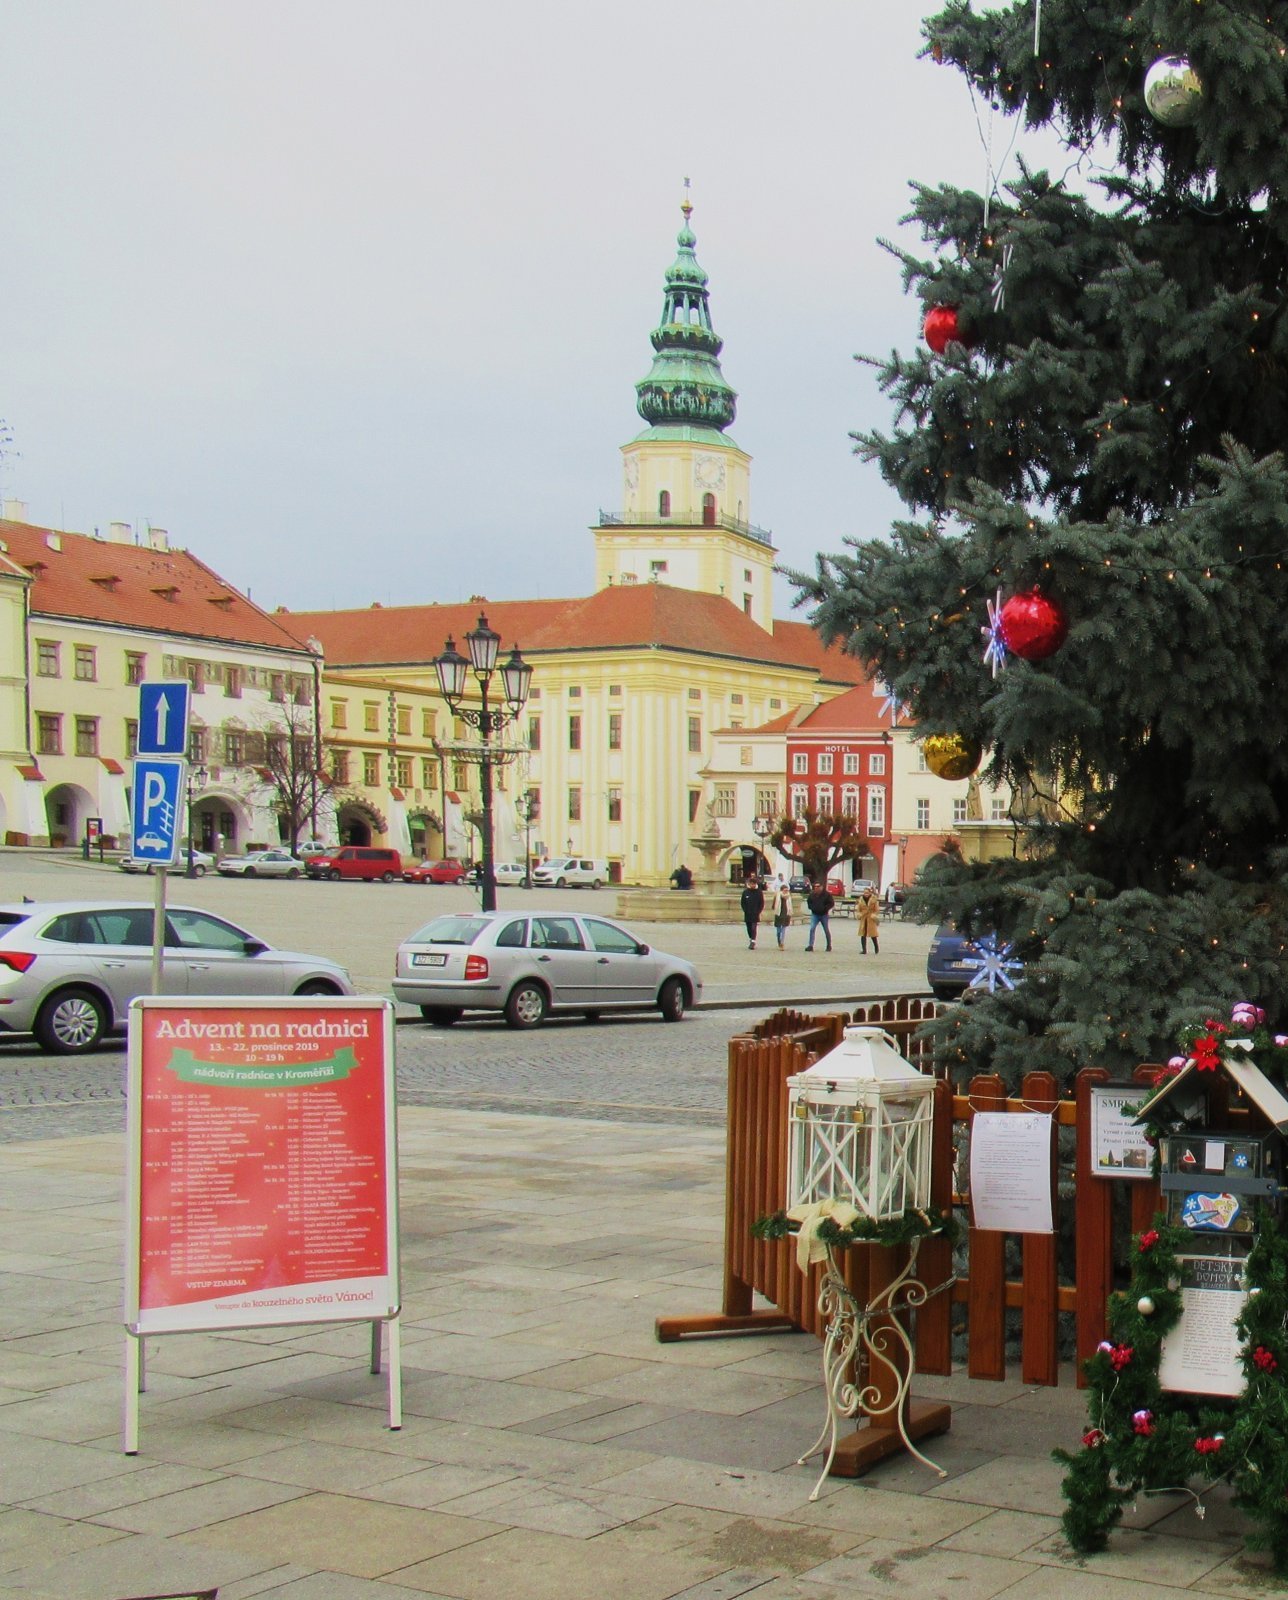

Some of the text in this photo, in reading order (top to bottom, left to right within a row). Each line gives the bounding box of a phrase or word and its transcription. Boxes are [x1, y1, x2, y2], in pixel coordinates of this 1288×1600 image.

[825, 745, 851, 753] HOTEL
[143, 772, 166, 825] P
[156, 1019, 369, 1039] Advent na radnici
[209, 1043, 225, 1052] 13.
[233, 1043, 249, 1052] 22.
[251, 1042, 294, 1053] prosince
[296, 1043, 319, 1051] 2019
[245, 1054, 256, 1062] 10
[278, 1054, 284, 1062] h
[193, 1067, 234, 1079] nádvoří
[236, 1068, 274, 1080] radnice
[187, 1279, 247, 1289] VSTUP ZDARMA
[305, 1295, 333, 1305] světa
[335, 1290, 374, 1303] Vánoc!
